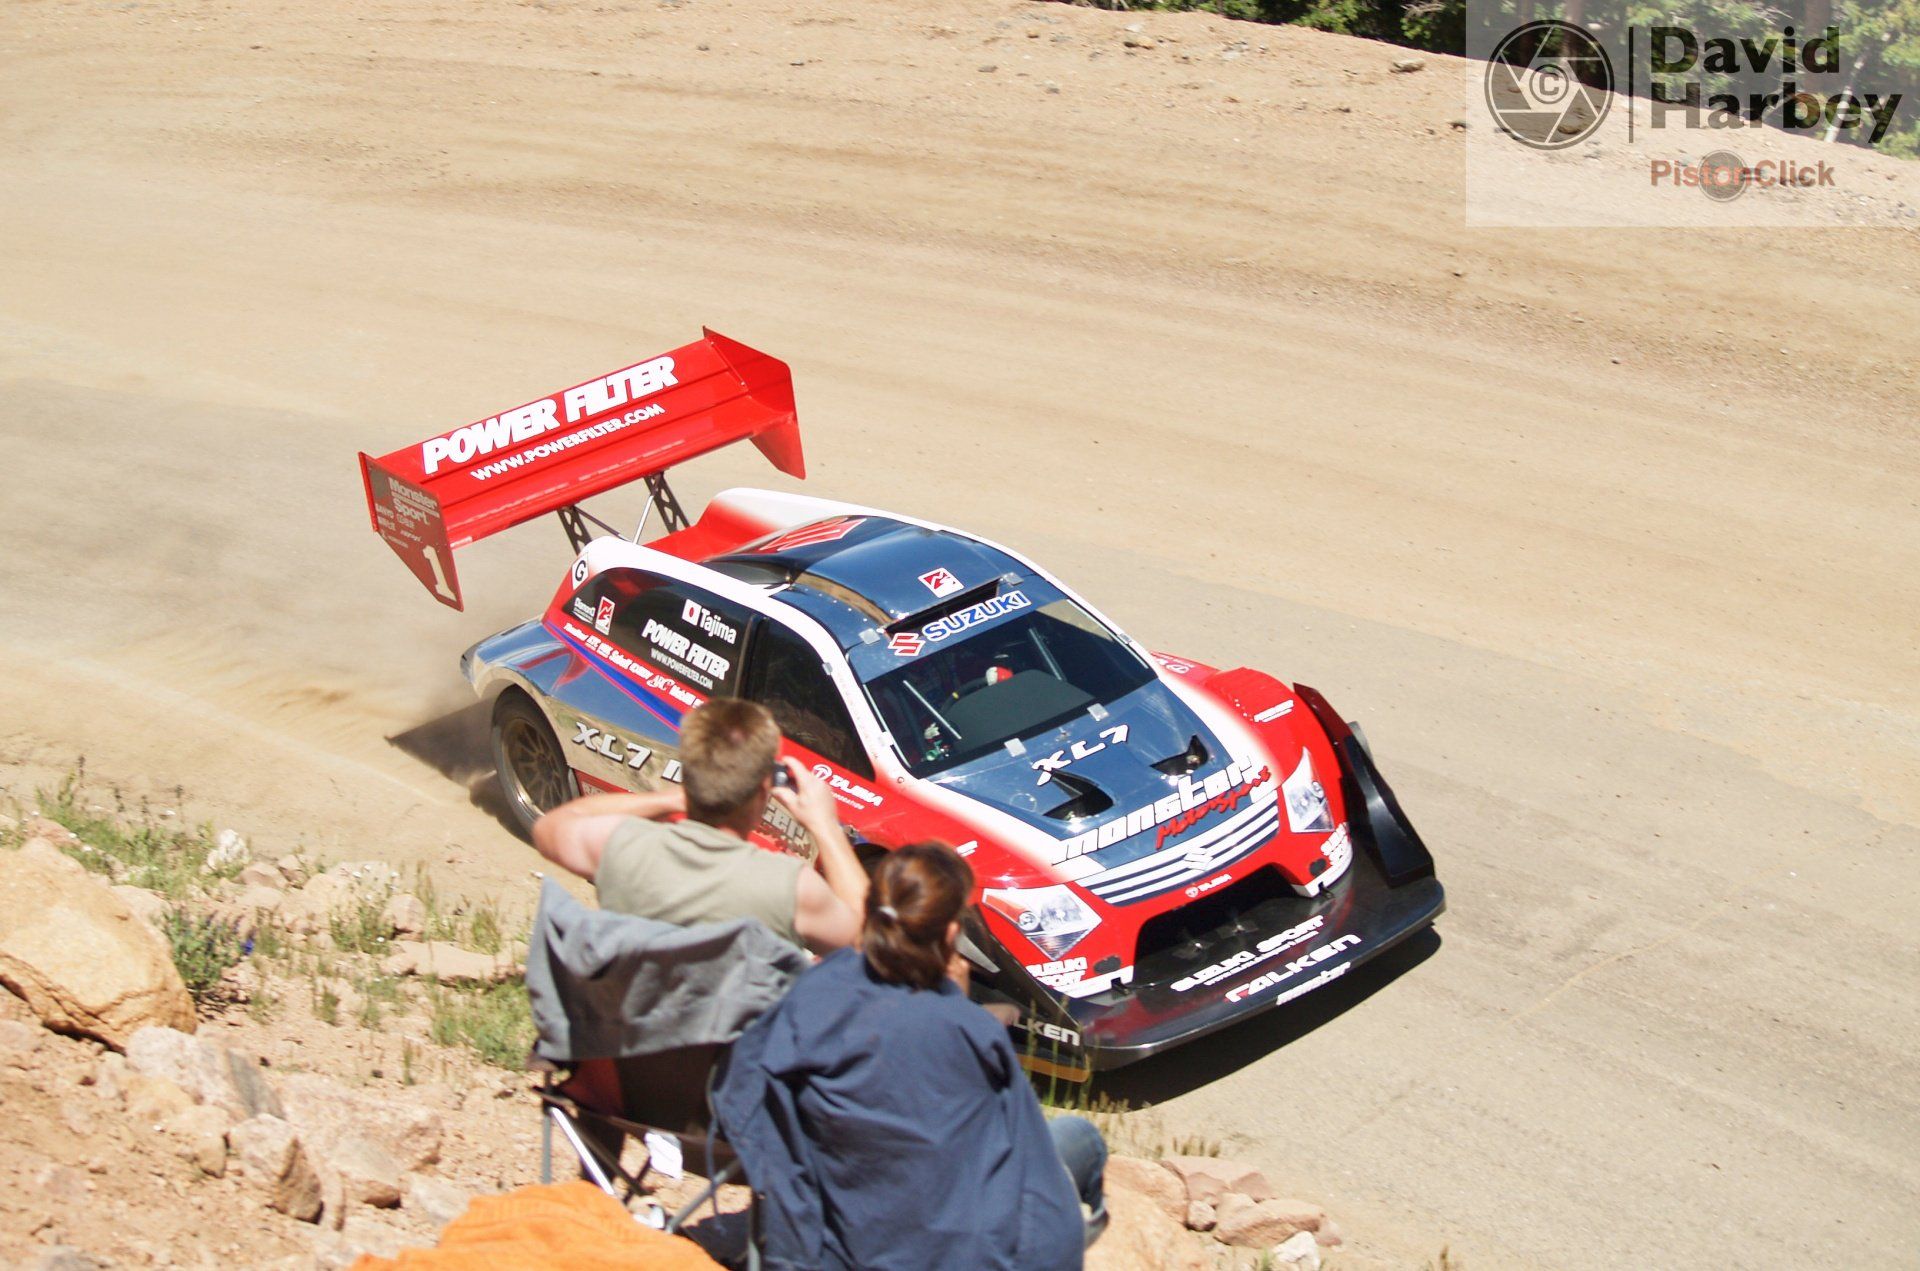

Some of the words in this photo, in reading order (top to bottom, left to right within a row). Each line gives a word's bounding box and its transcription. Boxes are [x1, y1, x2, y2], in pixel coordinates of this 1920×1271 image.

[422, 399, 561, 475] POWER
[563, 356, 679, 423] FILTER
[470, 403, 666, 480] WWW.POWERFILTER.COM
[422, 545, 457, 602] 1
[575, 560, 586, 581] G
[700, 608, 737, 644] Tajima
[922, 591, 1031, 641] SUZUKI
[641, 618, 690, 659] POWER
[685, 642, 730, 681] FILTER
[572, 721, 652, 770] XL7
[1031, 724, 1129, 786] XL7
[1256, 914, 1324, 953] SPORT
